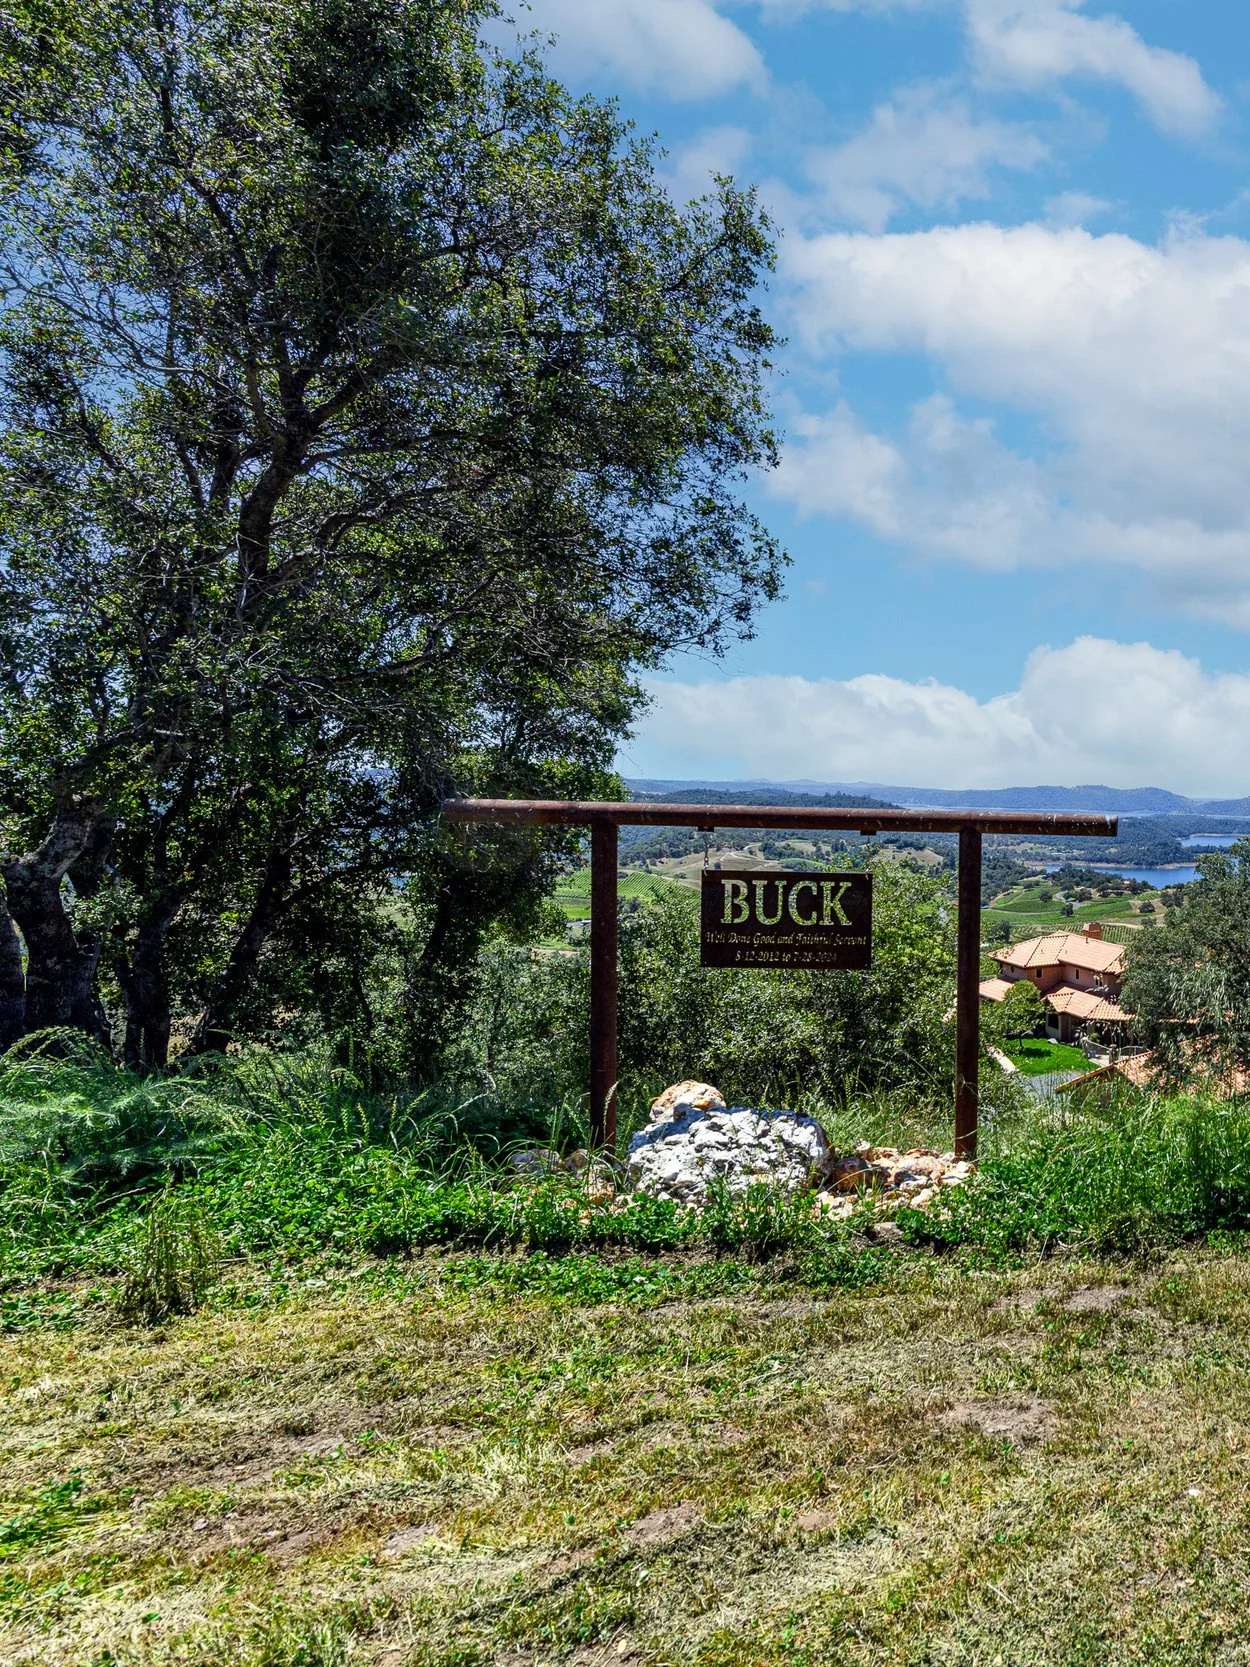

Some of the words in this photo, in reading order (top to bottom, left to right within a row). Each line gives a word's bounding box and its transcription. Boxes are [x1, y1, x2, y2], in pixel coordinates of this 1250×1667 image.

[720, 879, 853, 926] BUCK
[704, 931, 726, 944] Well
[728, 932, 751, 944] Done
[753, 931, 777, 947] Good
[777, 932, 796, 944] and
[796, 932, 834, 946] Faithful
[834, 933, 867, 946] Servant
[782, 952, 792, 962] to
